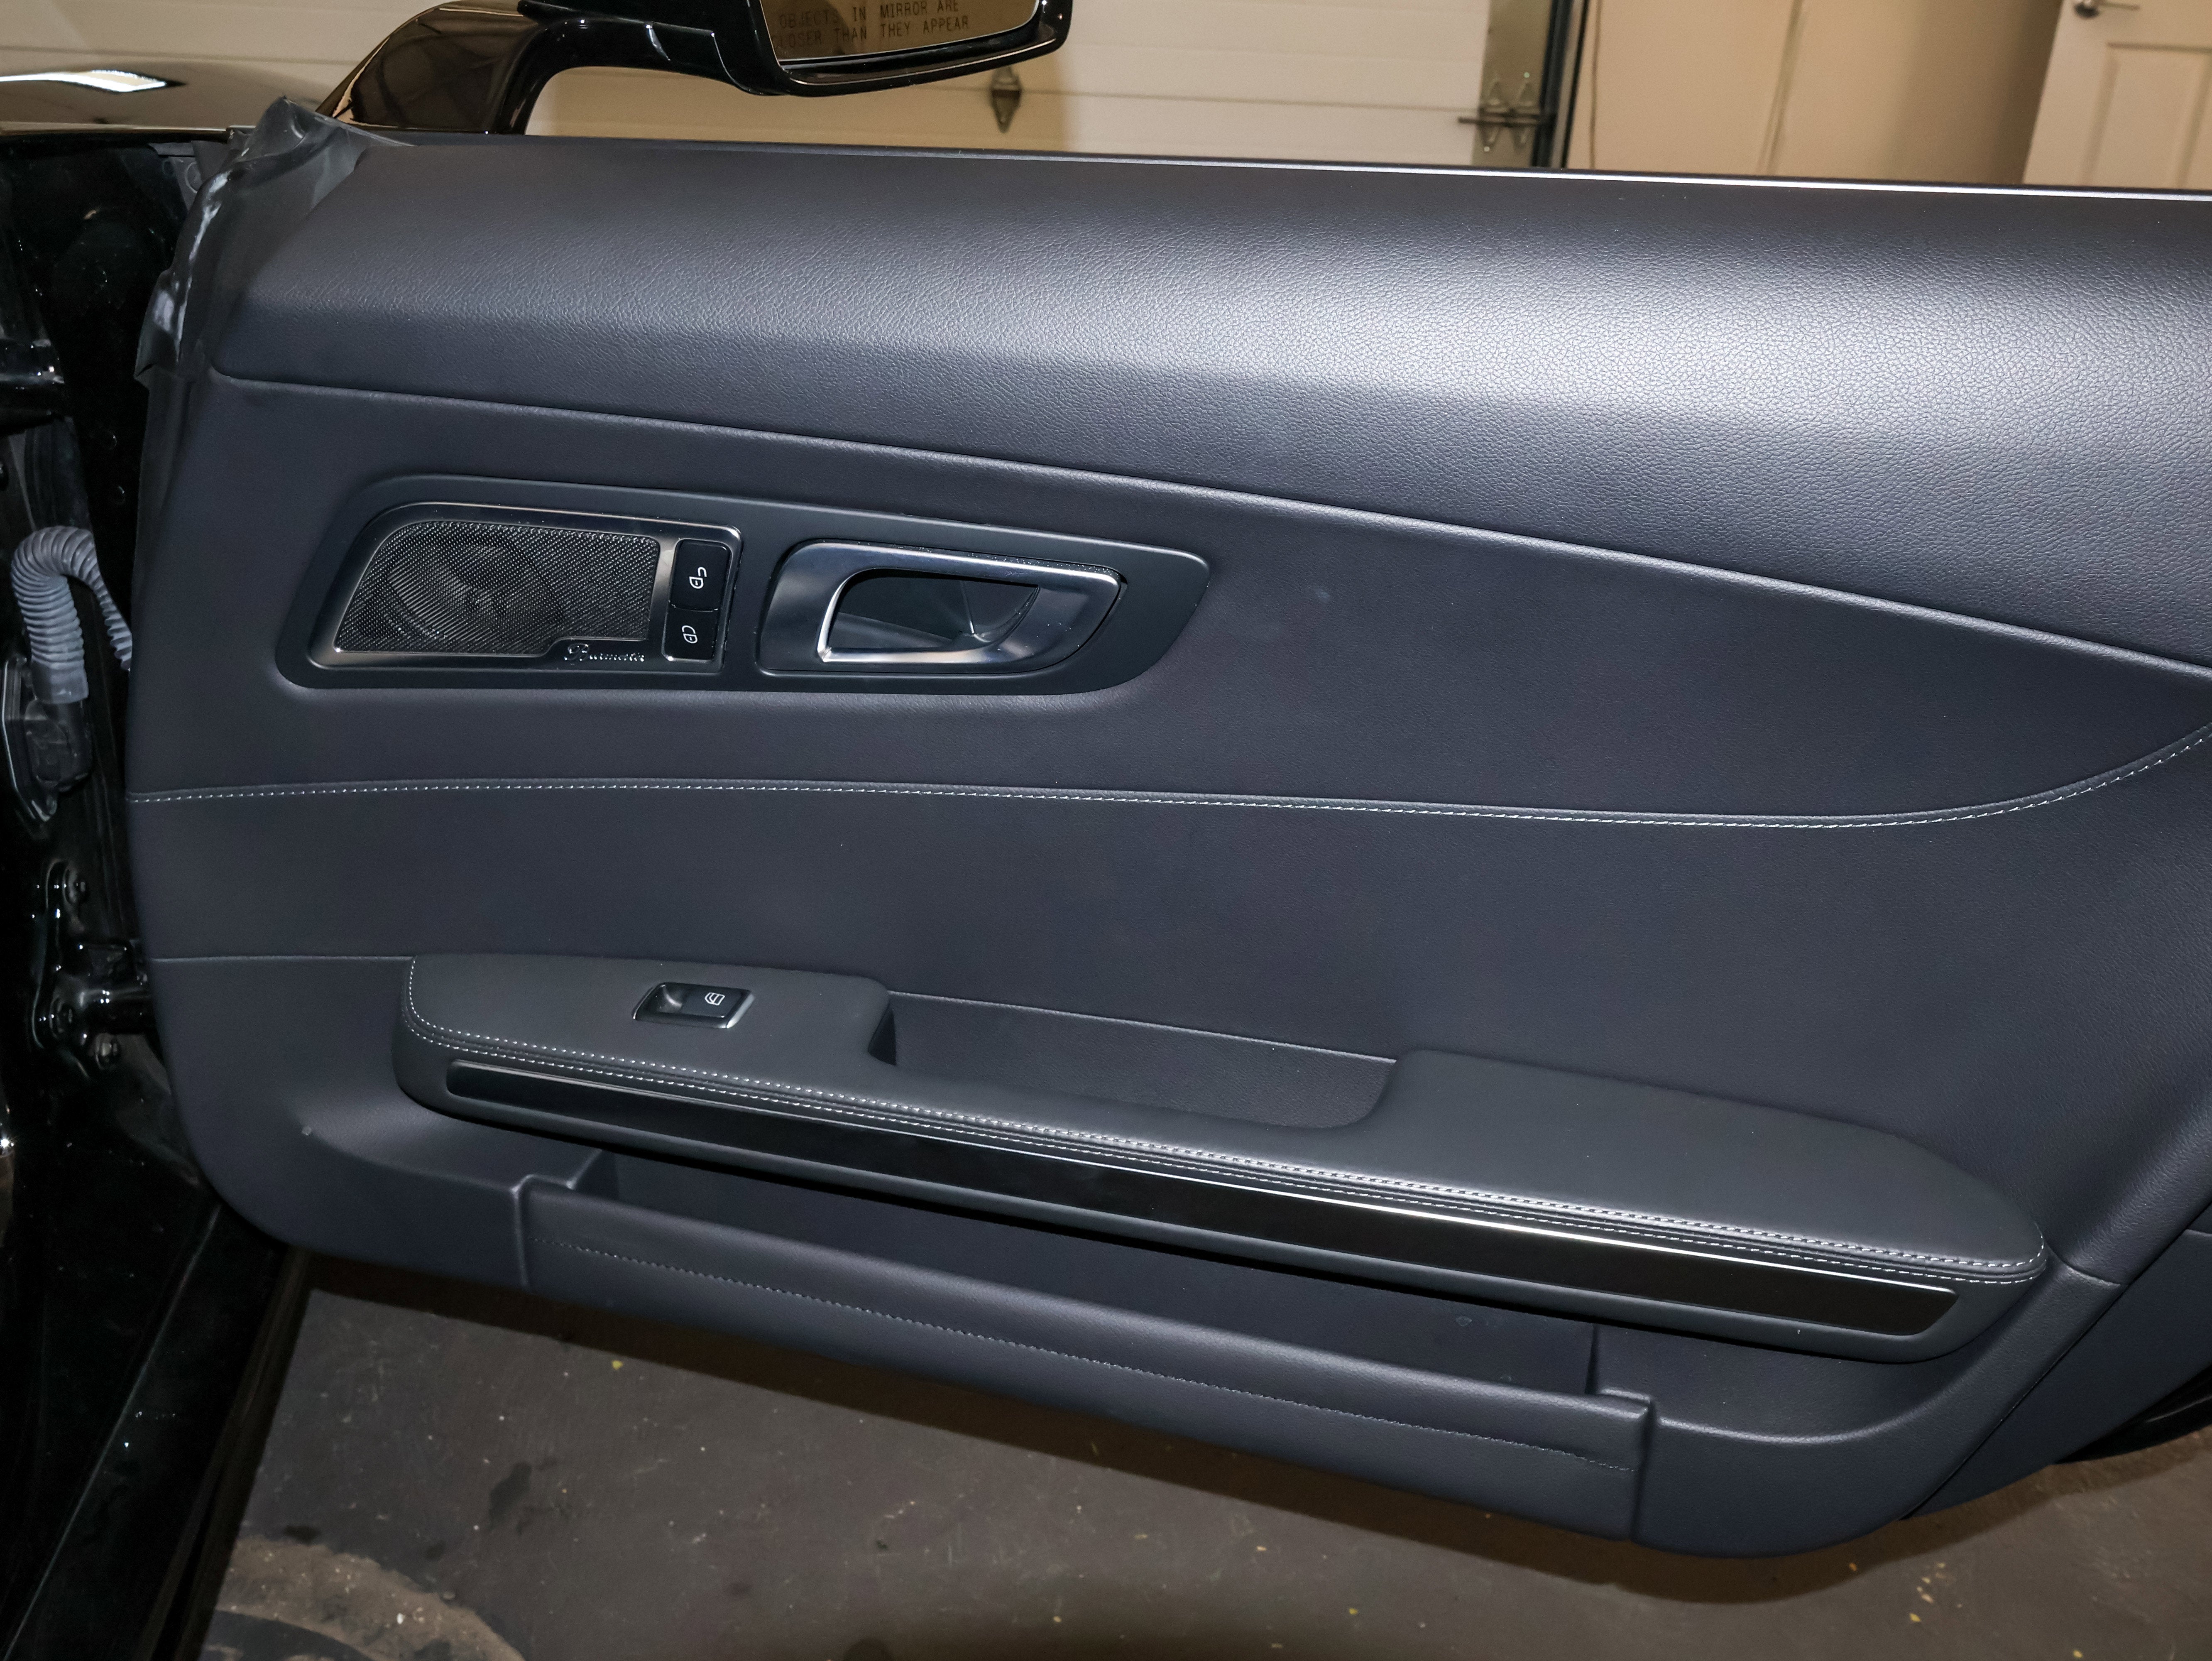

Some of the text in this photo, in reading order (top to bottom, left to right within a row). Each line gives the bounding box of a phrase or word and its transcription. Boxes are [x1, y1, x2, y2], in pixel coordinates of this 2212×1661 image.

[779, 0, 959, 29] OBJECTS IN MIRROR ARE
[834, 27, 867, 42] THAN
[880, 21, 910, 38] THEY
[923, 15, 969, 34] APPEAR
